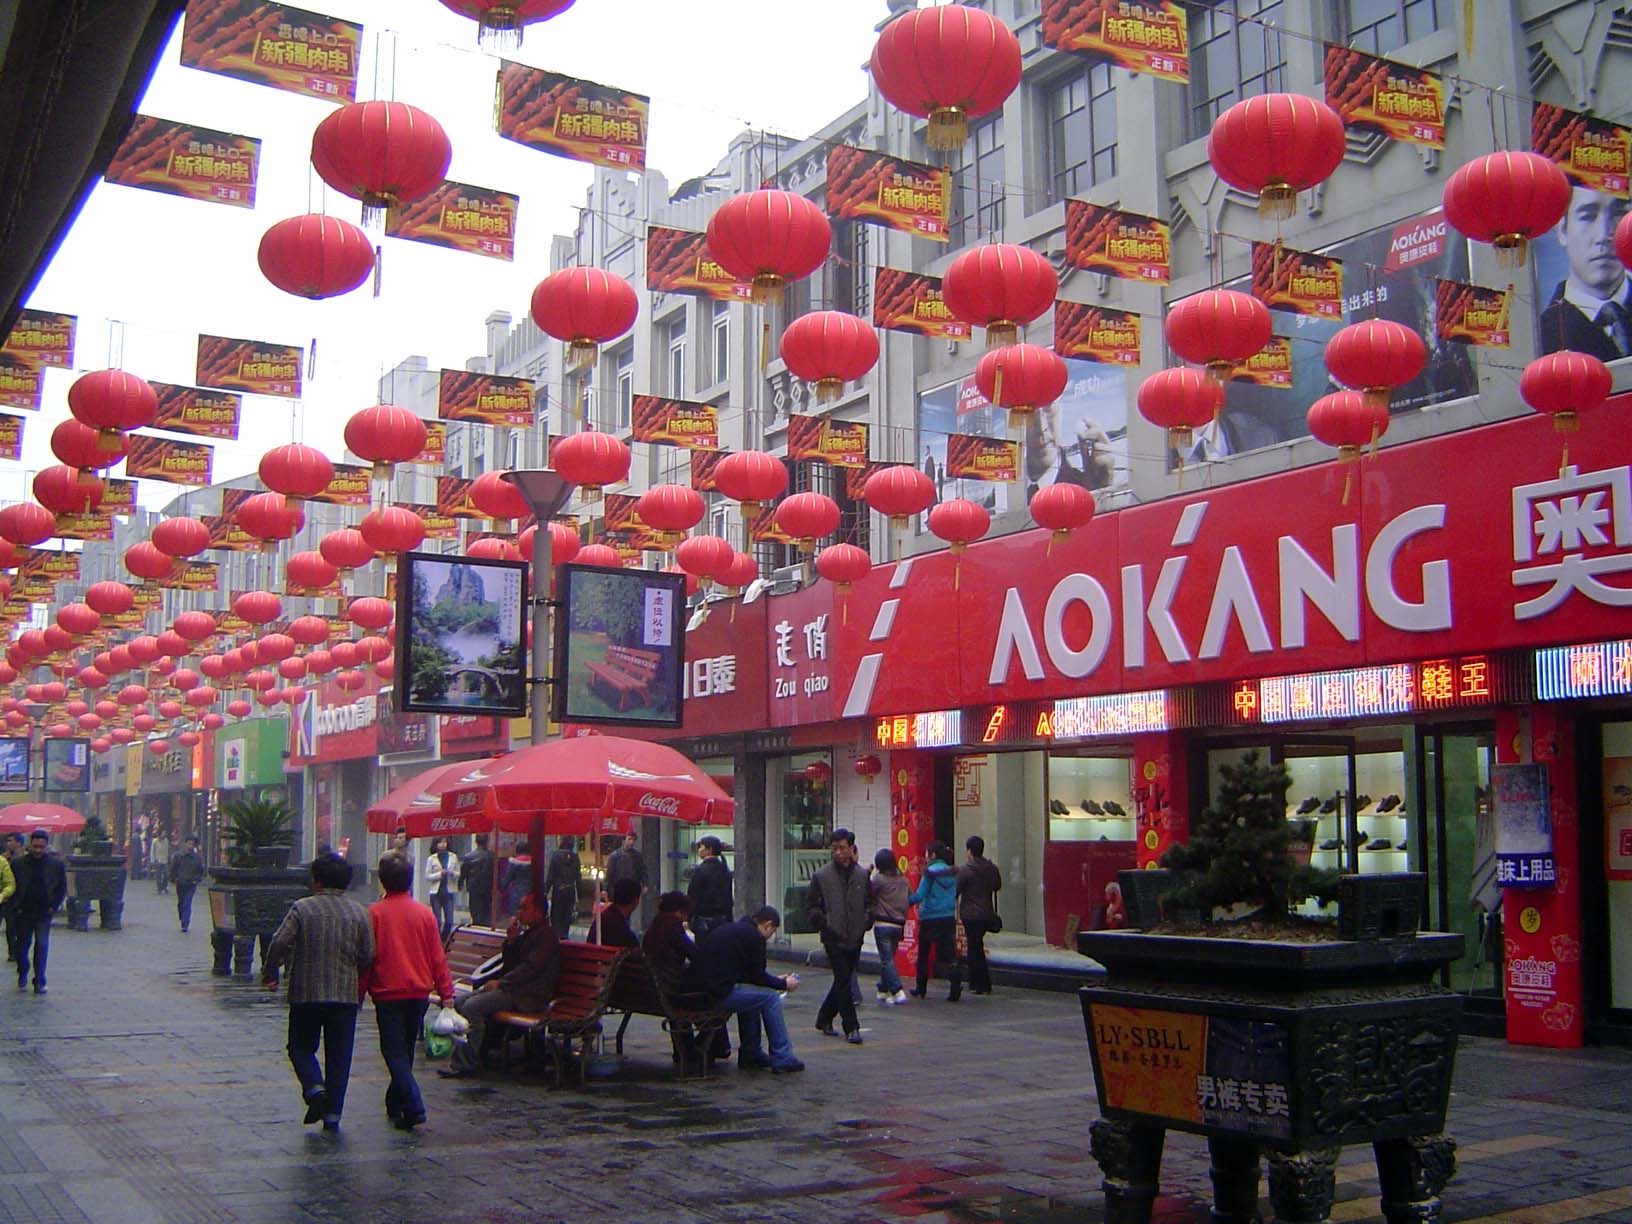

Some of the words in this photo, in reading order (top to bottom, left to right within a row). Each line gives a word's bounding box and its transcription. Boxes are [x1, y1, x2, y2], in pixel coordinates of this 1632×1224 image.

[1108, 18, 1178, 48] 新疆肉串
[261, 39, 348, 72] 新疆肉串
[1378, 91, 1436, 118] 新疆肉串
[561, 113, 638, 142] 新疆肉串
[175, 156, 249, 181] 新疆肉串
[884, 188, 941, 213] 新疆肉串
[446, 210, 508, 235] 新疆肉串
[1110, 239, 1162, 260] 新疆肉串
[1391, 223, 1447, 252] AOKANG
[775, 614, 829, 667] 走俏
[775, 678, 797, 698] Zou
[804, 671, 829, 698] qiao
[1197, 1074, 1290, 1118] 男裤专卖
